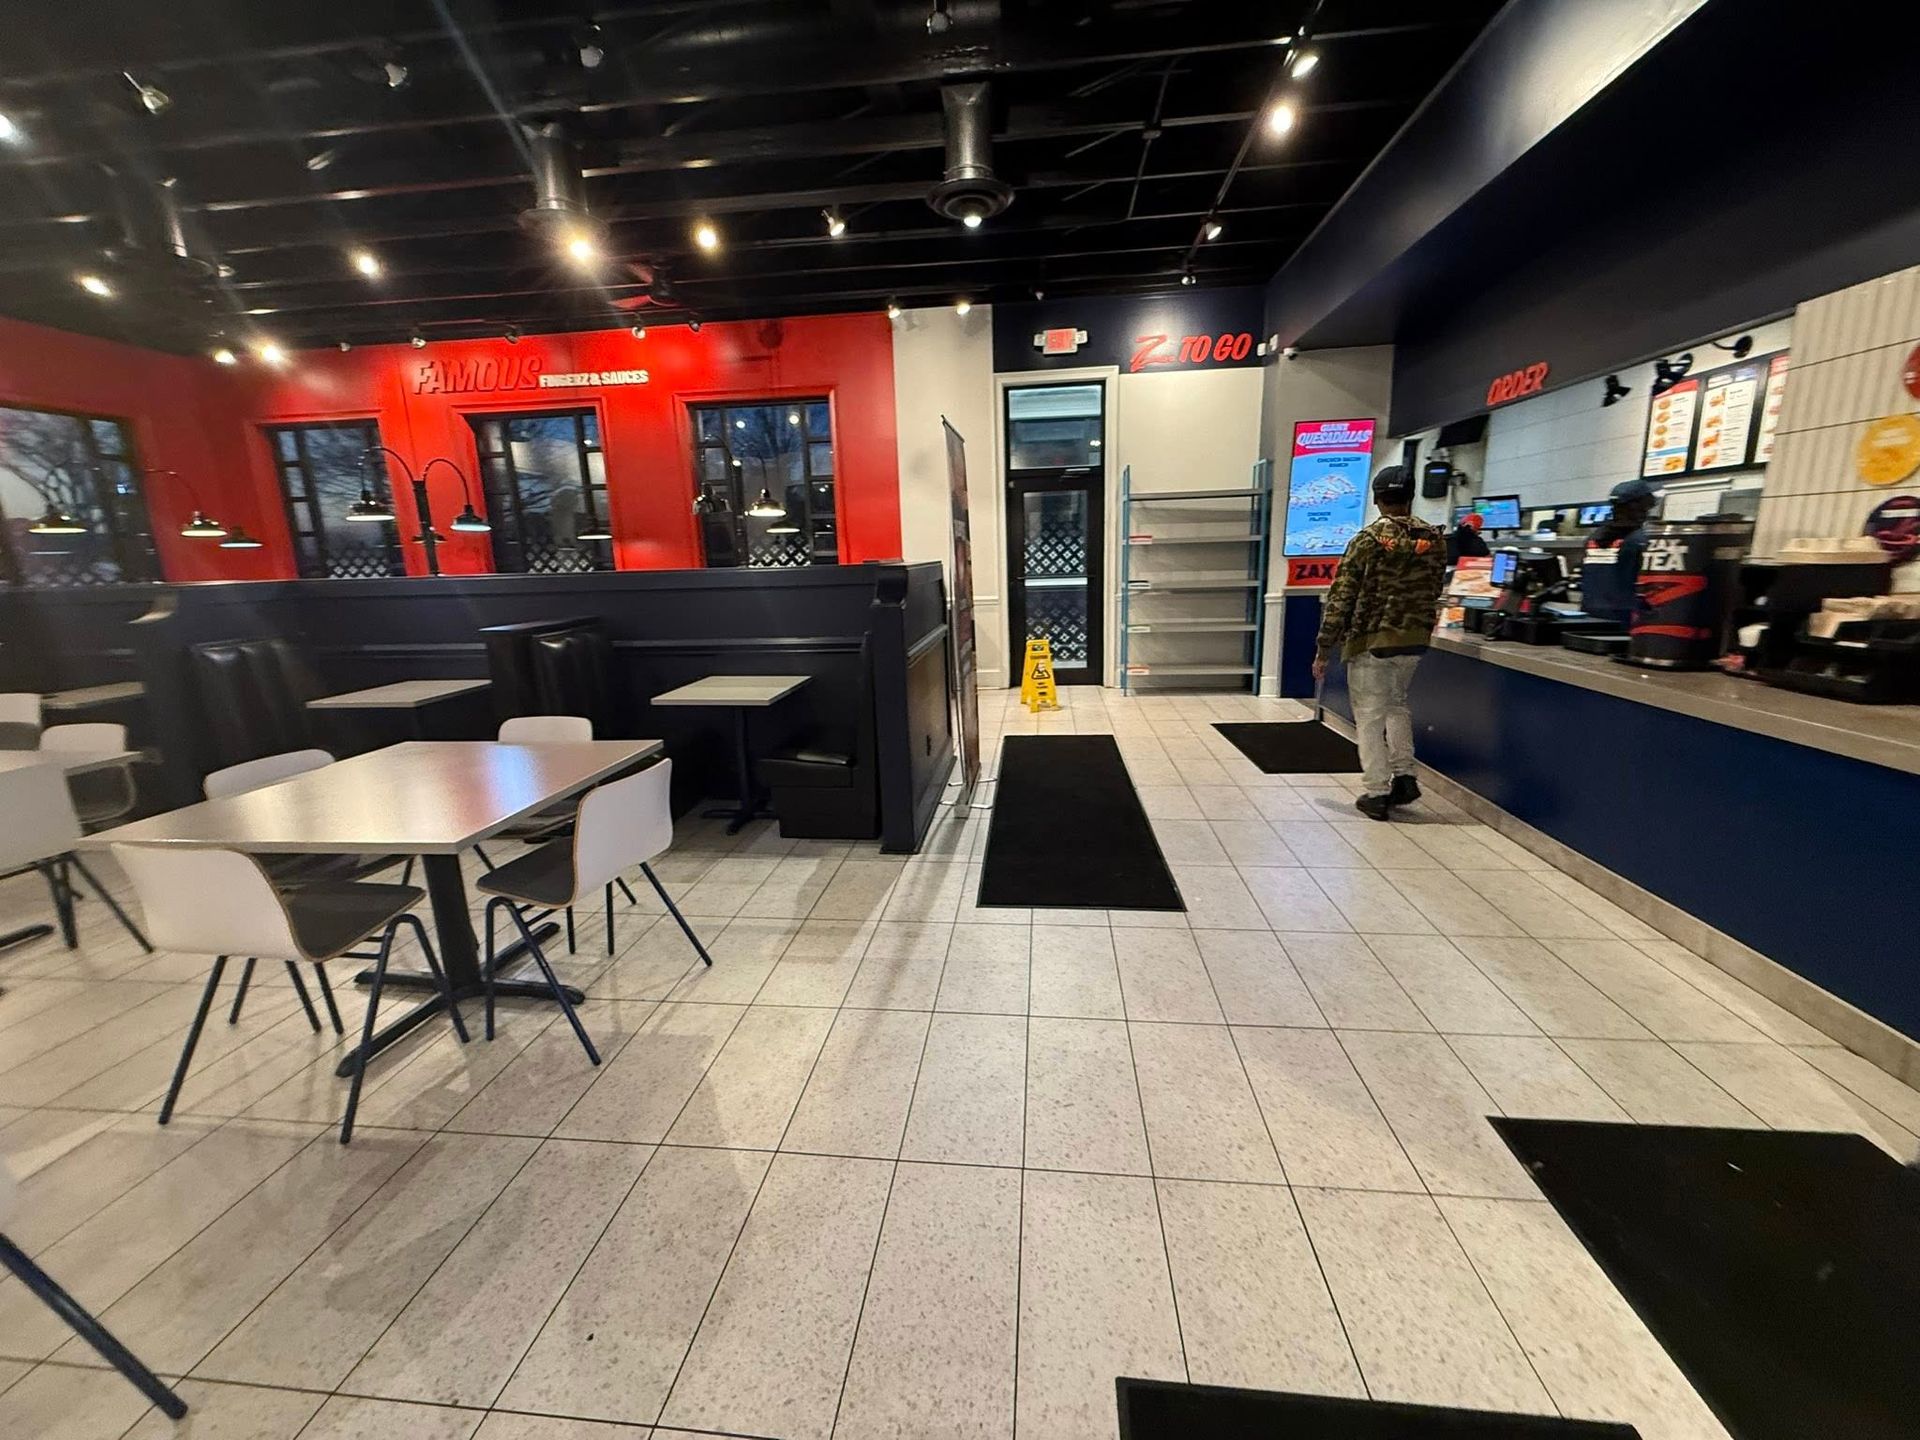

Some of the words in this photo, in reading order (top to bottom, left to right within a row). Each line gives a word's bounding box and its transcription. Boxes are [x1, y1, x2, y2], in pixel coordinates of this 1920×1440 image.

[1129, 334, 1175, 373] Z
[1179, 335, 1212, 363] TO
[1213, 333, 1252, 362] GO
[413, 356, 542, 395] FAMOUS
[589, 373, 602, 386] &
[601, 370, 649, 385] SAUCES
[1486, 361, 1549, 406] ORDER
[1297, 430, 1373, 446] QUESADILLAS
[1641, 549, 1687, 571] TEA
